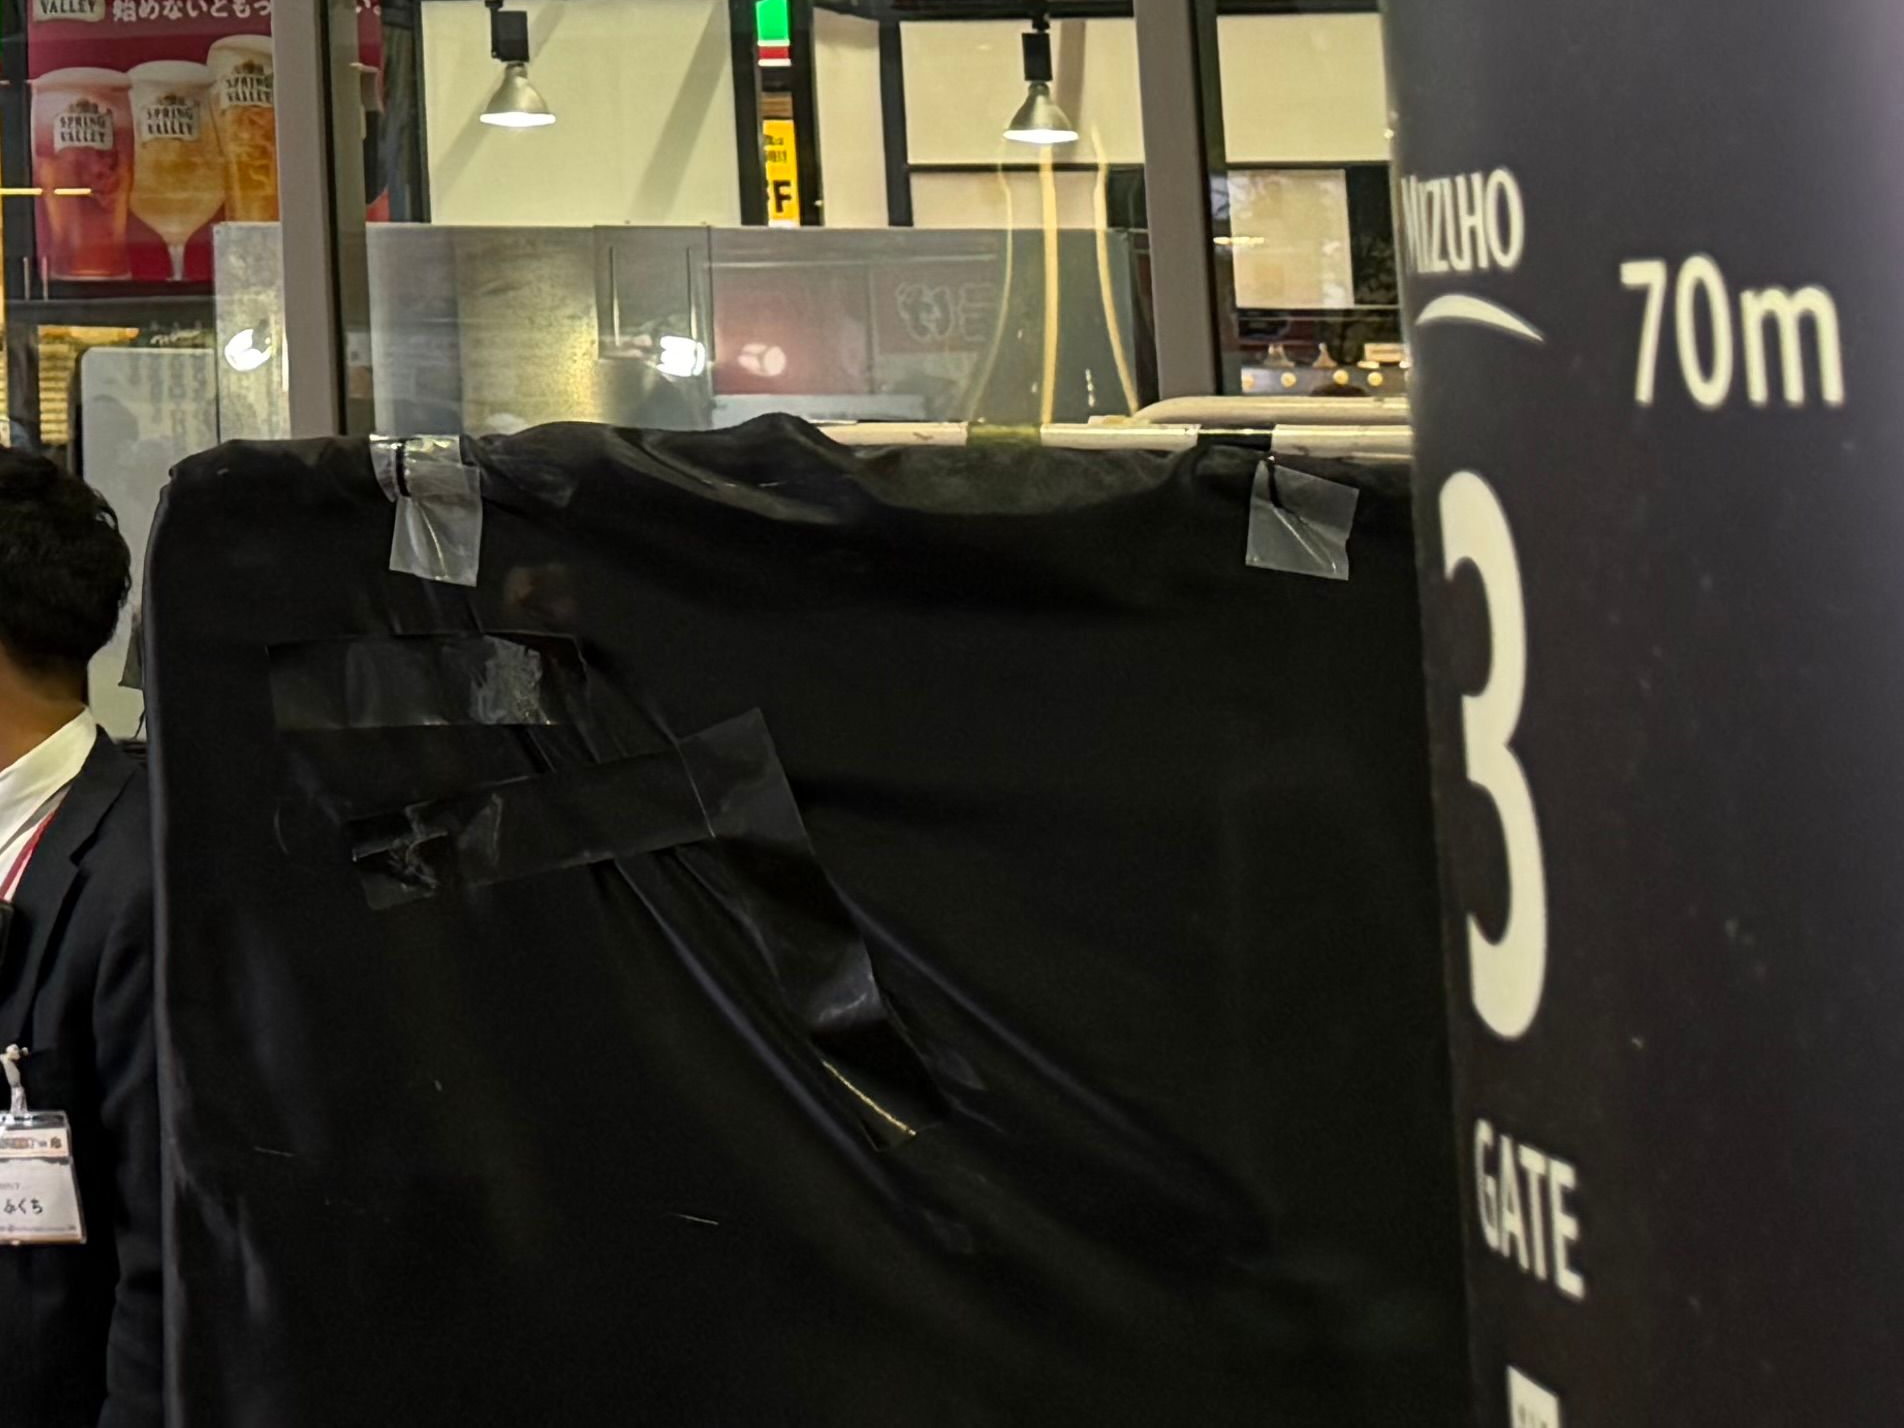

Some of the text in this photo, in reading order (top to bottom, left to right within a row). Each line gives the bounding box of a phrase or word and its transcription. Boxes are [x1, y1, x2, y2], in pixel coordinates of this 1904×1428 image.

[1620, 254, 1846, 408] 70m
[1439, 470, 1547, 1039] 3
[1475, 1118, 1585, 1301] GATE
